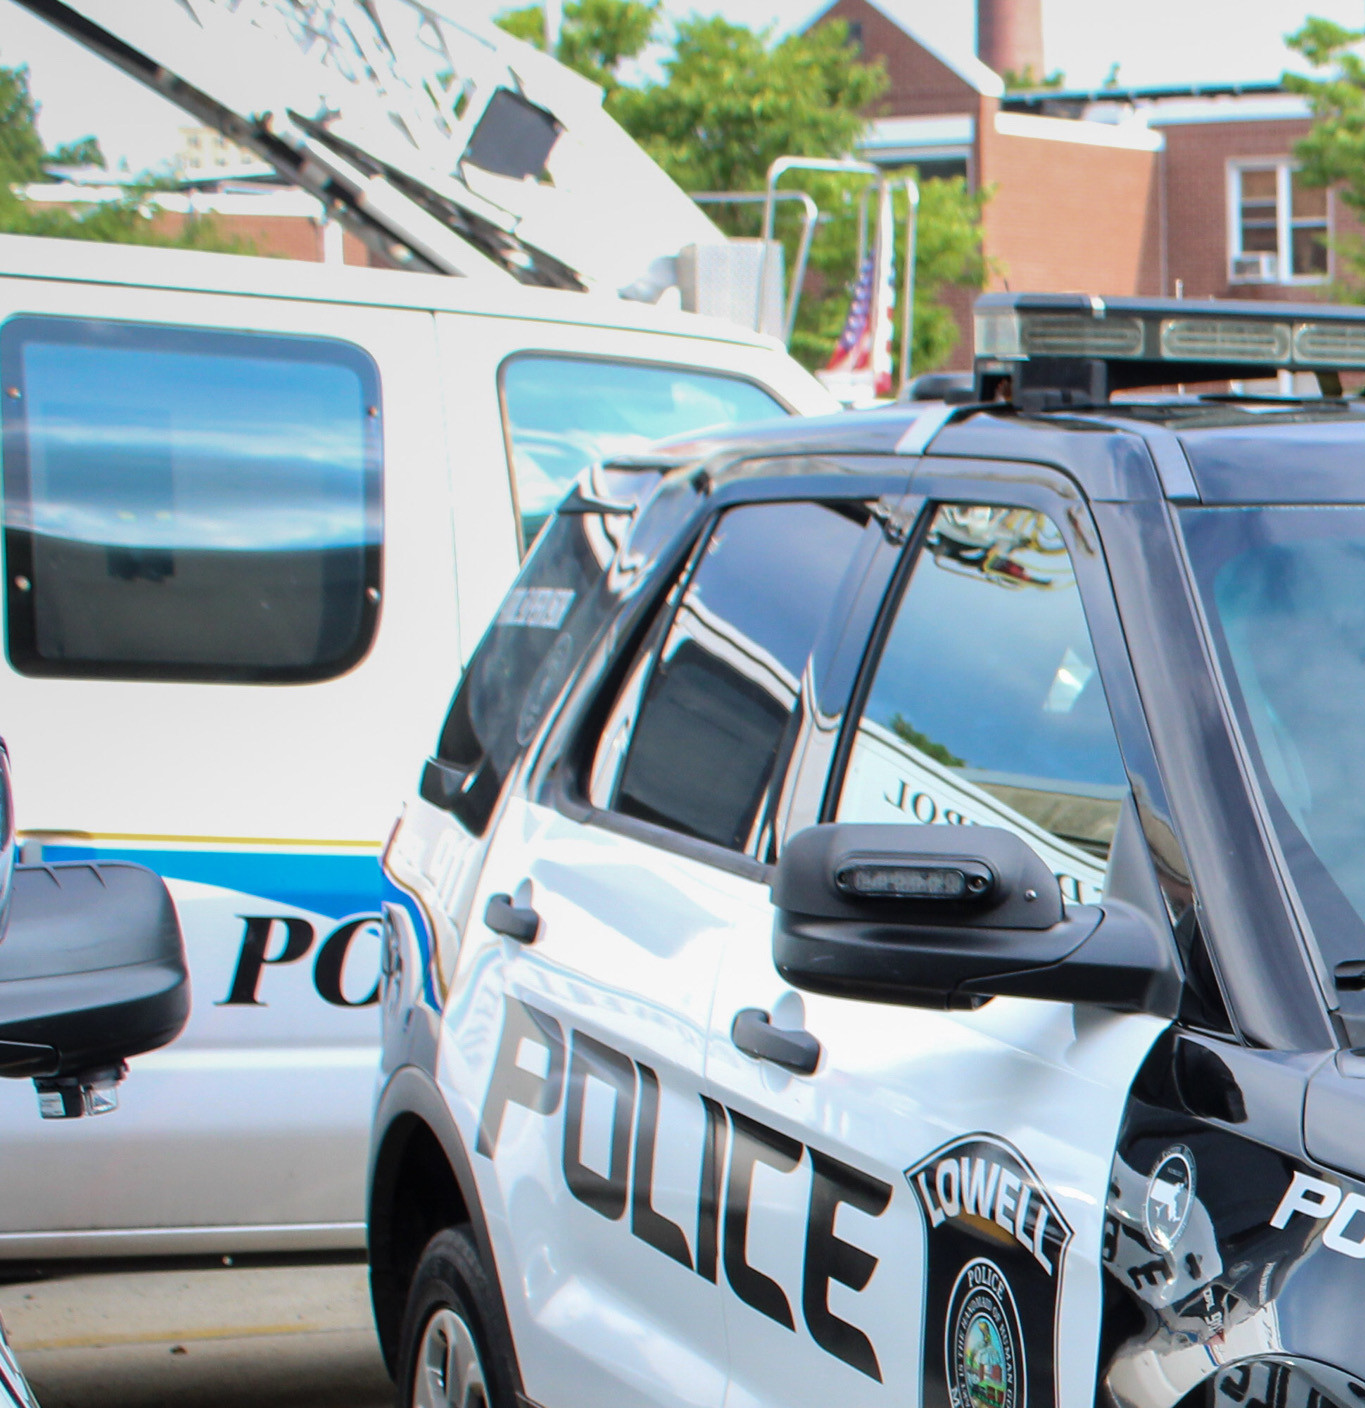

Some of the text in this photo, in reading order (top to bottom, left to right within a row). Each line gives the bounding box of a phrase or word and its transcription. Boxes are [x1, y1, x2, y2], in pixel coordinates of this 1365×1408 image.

[477, 992, 893, 1384] POLICE
[917, 1157, 1053, 1276] LOWELL
[967, 1265, 1005, 1301] POLICE
